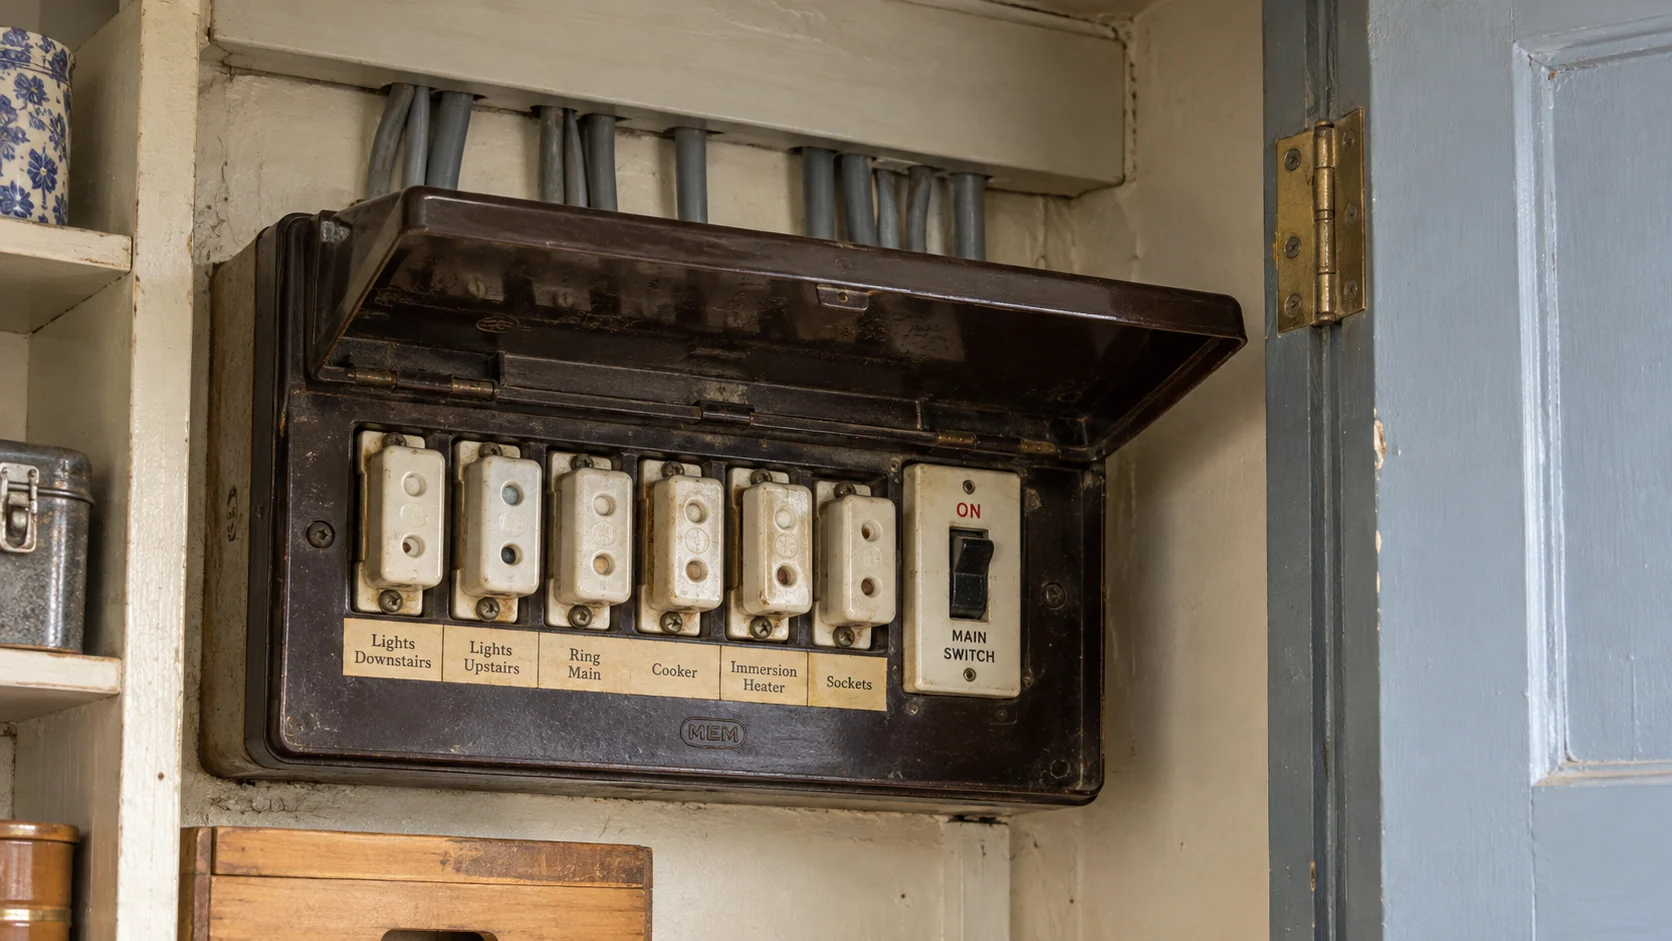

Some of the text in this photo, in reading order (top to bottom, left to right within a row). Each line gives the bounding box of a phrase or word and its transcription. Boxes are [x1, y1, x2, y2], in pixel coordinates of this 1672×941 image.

[956, 502, 981, 519] ON
[371, 633, 415, 651] Lights
[952, 629, 987, 644] MAIN
[469, 640, 513, 658] Lights
[569, 648, 601, 666] Ring
[943, 647, 995, 663] SWITCH
[354, 650, 432, 669] Downstairs
[463, 658, 520, 675] Upstairs
[568, 666, 602, 681] Main
[651, 662, 698, 678] Cooker
[730, 660, 798, 678] Immersion
[743, 678, 785, 694] Heater
[826, 675, 873, 691] Sockets
[687, 723, 740, 743] MEM
